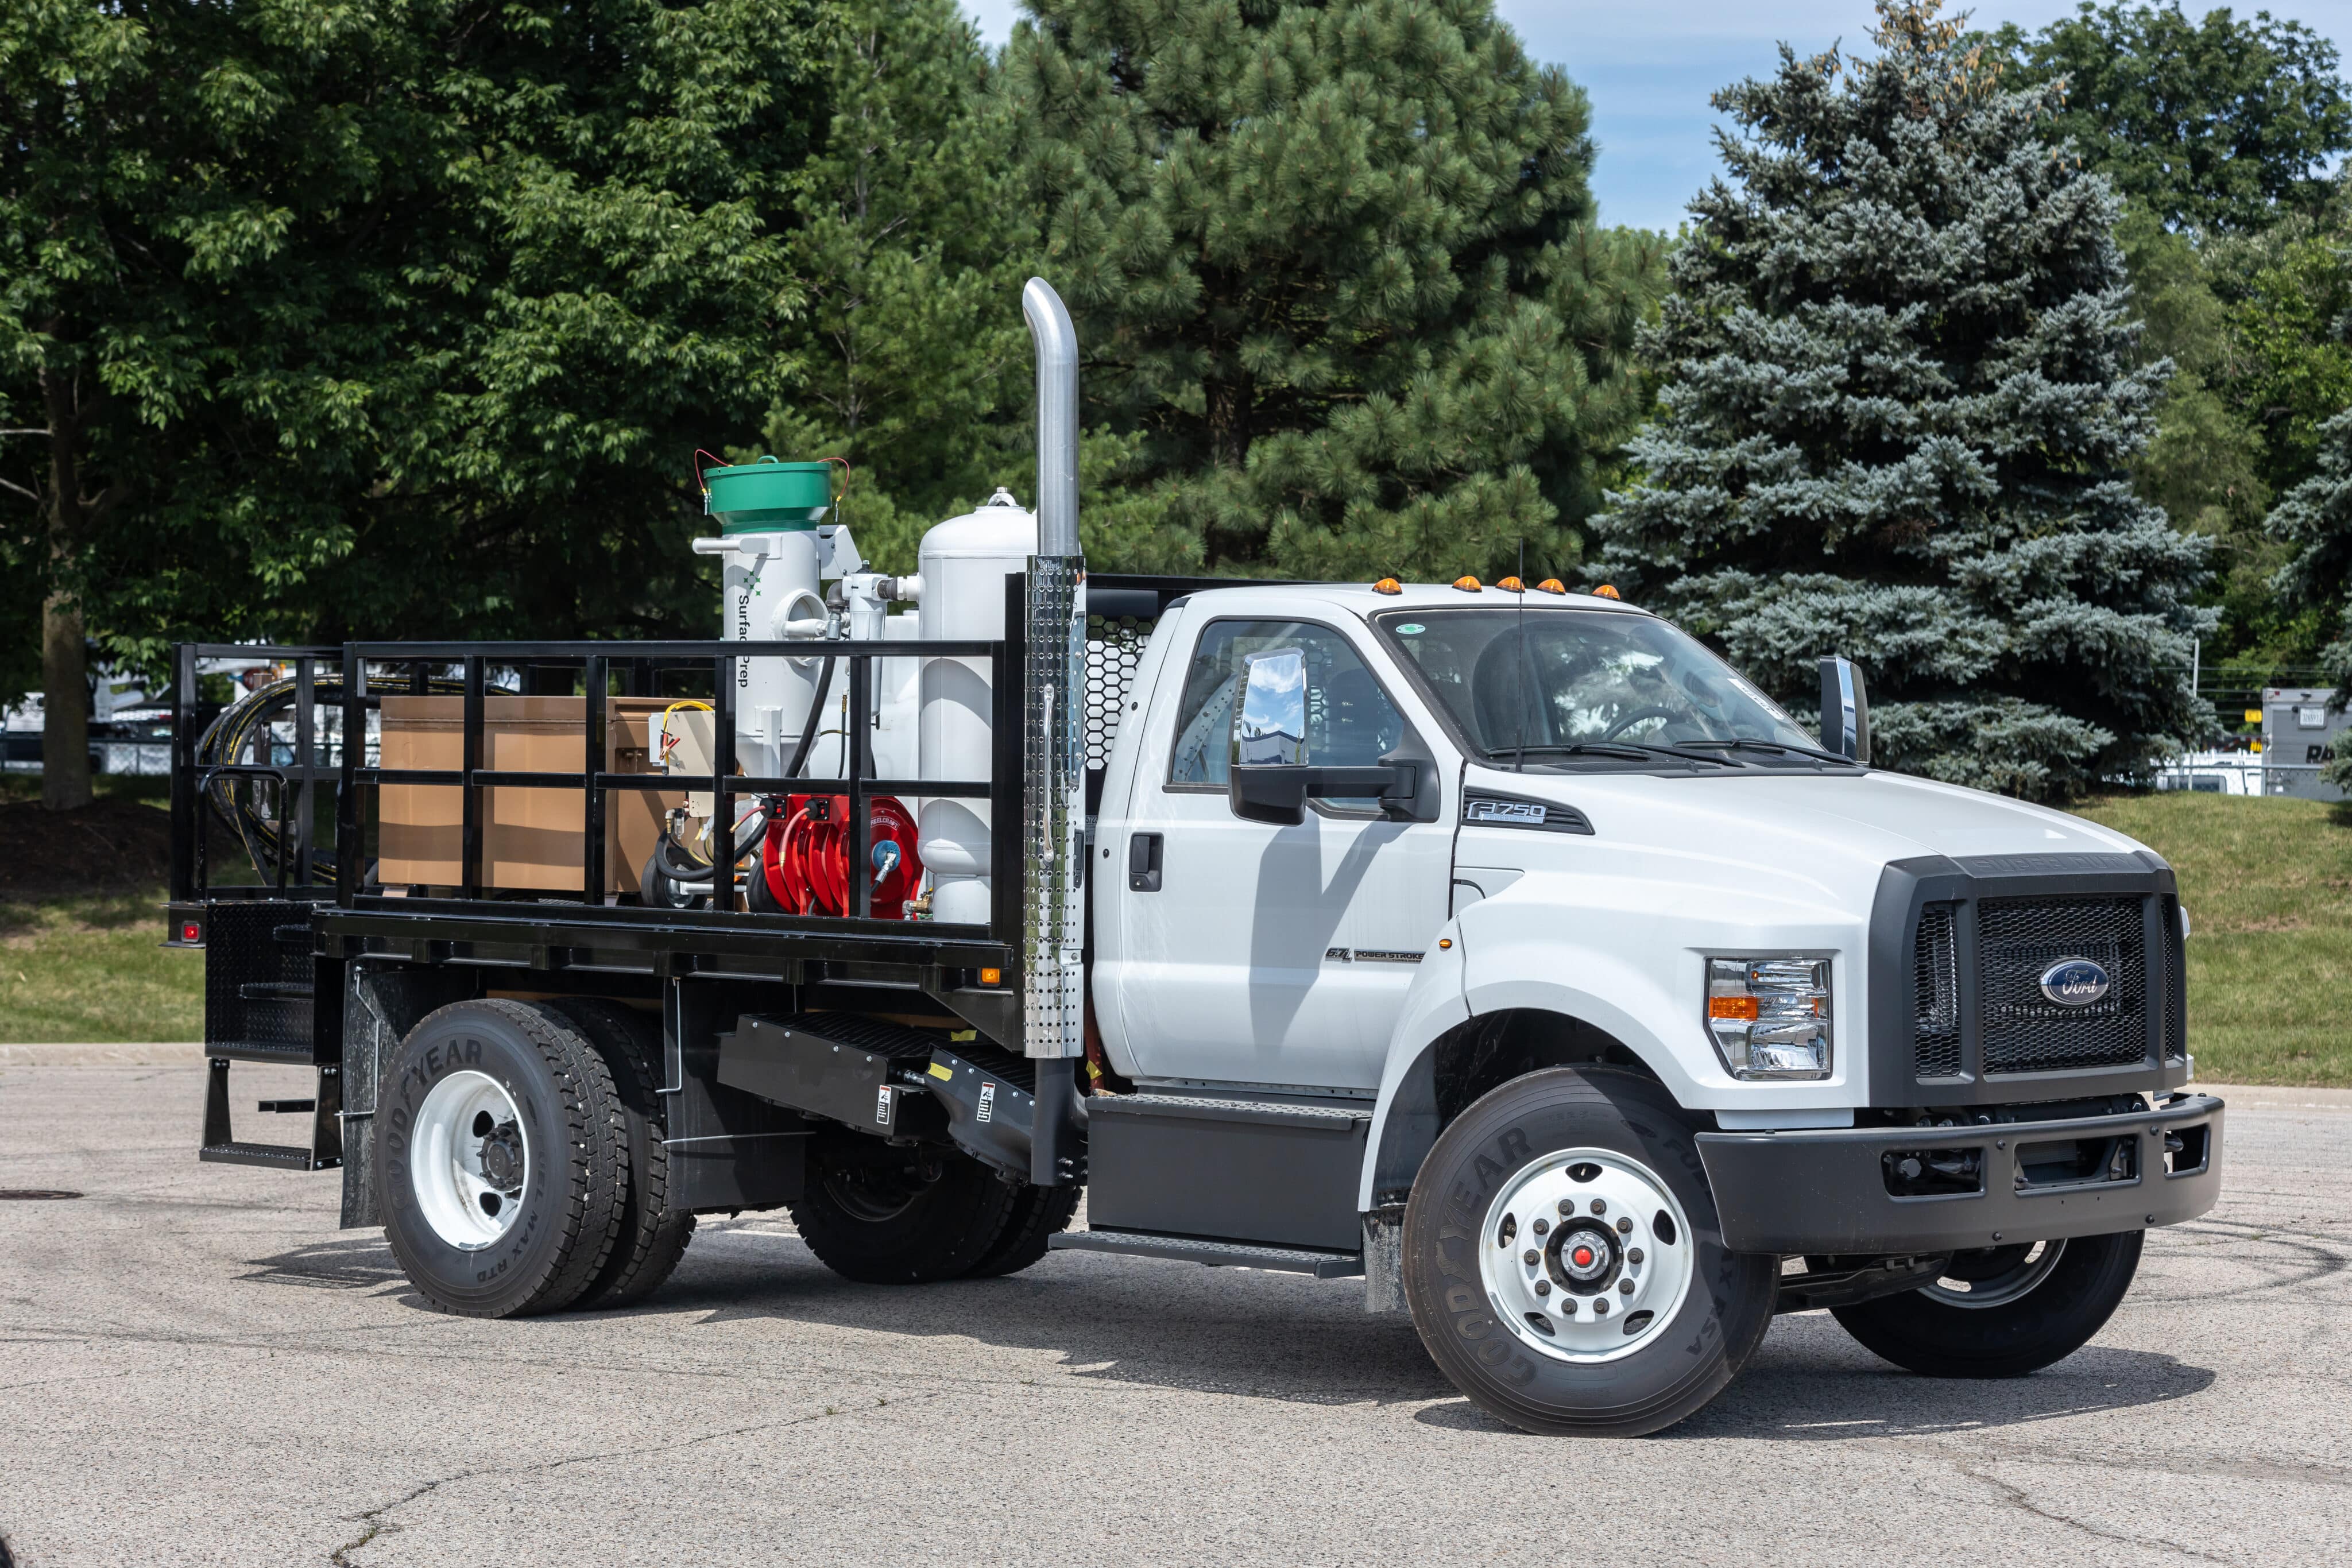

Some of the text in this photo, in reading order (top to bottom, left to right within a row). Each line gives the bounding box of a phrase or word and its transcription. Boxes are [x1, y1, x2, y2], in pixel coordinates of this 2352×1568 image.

[737, 595, 751, 688] SurfacPrep
[871, 816, 899, 828] REELCRAFT
[1970, 855, 2134, 872] SUPER DUTY
[1388, 952, 1424, 960] STROKE
[2062, 969, 2098, 995] Ford
[386, 1039, 482, 1210] GOODYEAR
[512, 1210, 538, 1261] MAX
[1439, 1126, 1537, 1386] GOODYEAR
[477, 1259, 508, 1282] RTD
